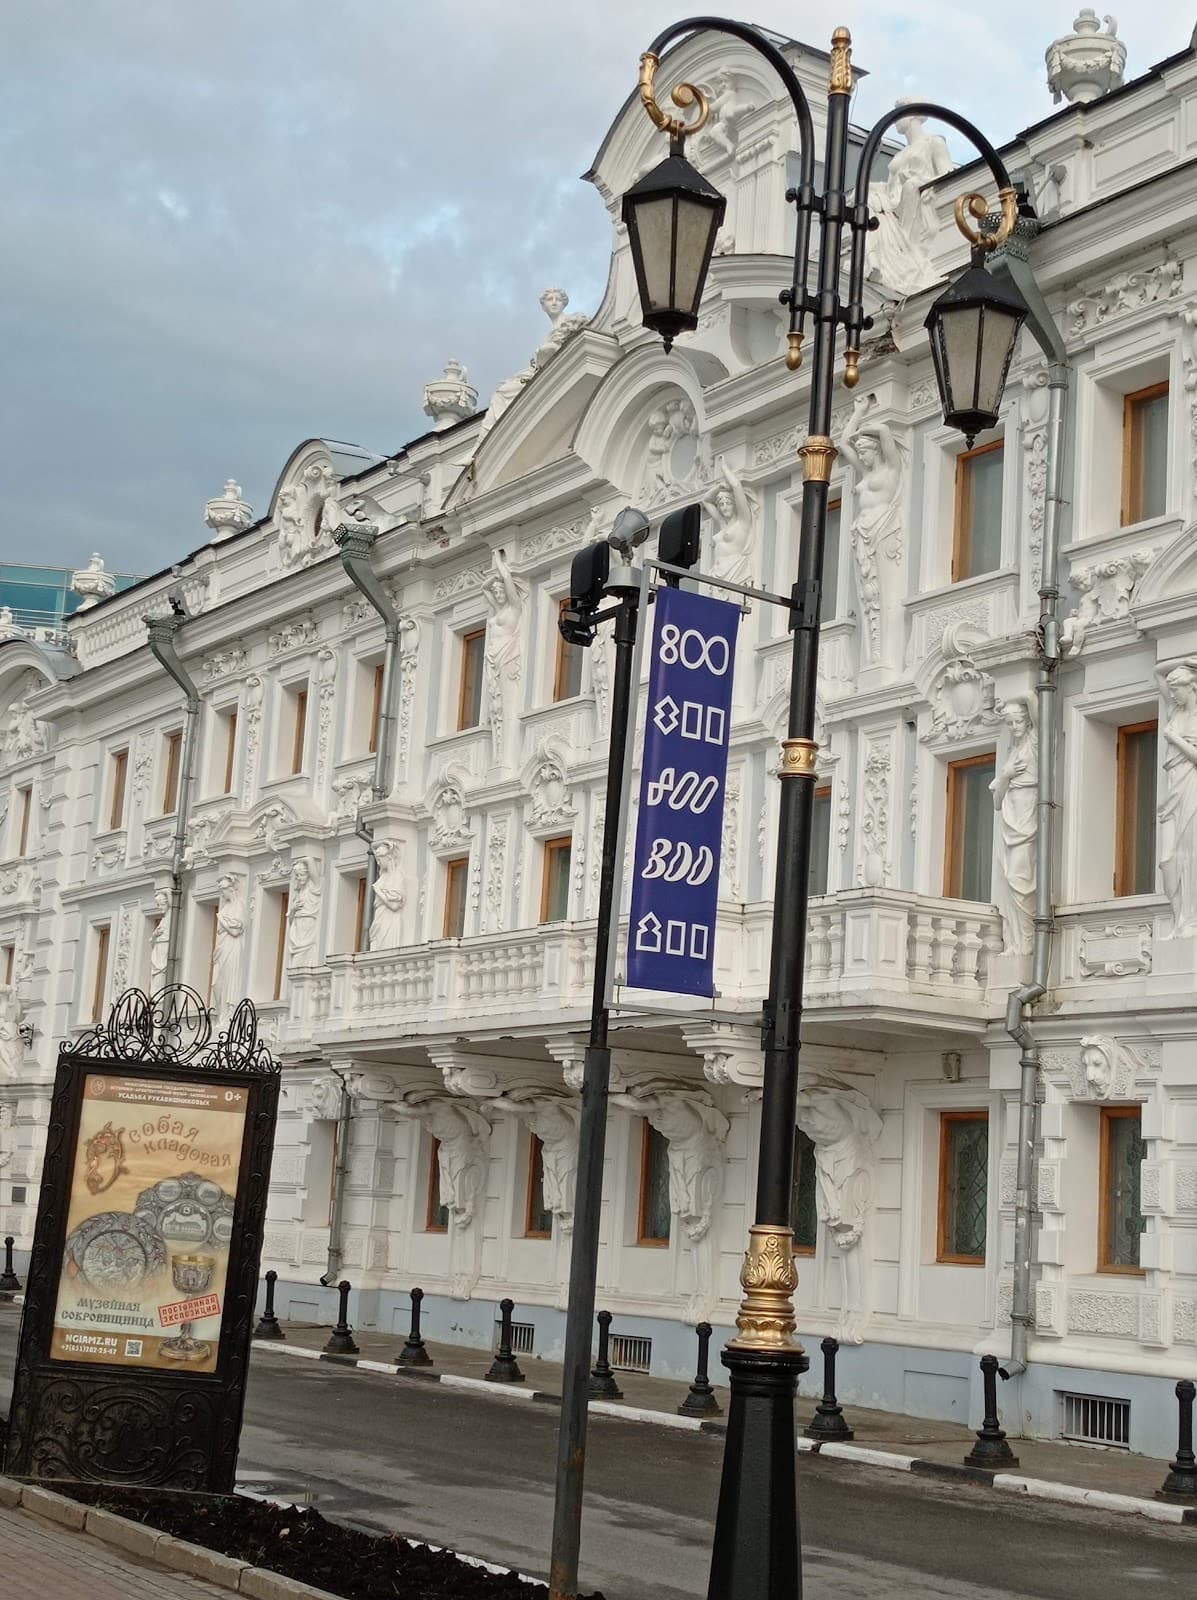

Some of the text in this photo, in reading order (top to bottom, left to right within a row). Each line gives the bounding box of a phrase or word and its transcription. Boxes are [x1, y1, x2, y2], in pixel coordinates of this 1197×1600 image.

[659, 624, 729, 676] 800
[225, 1091, 242, 1102] 0+
[65, 1333, 118, 1346] NGIAMZ.RU
